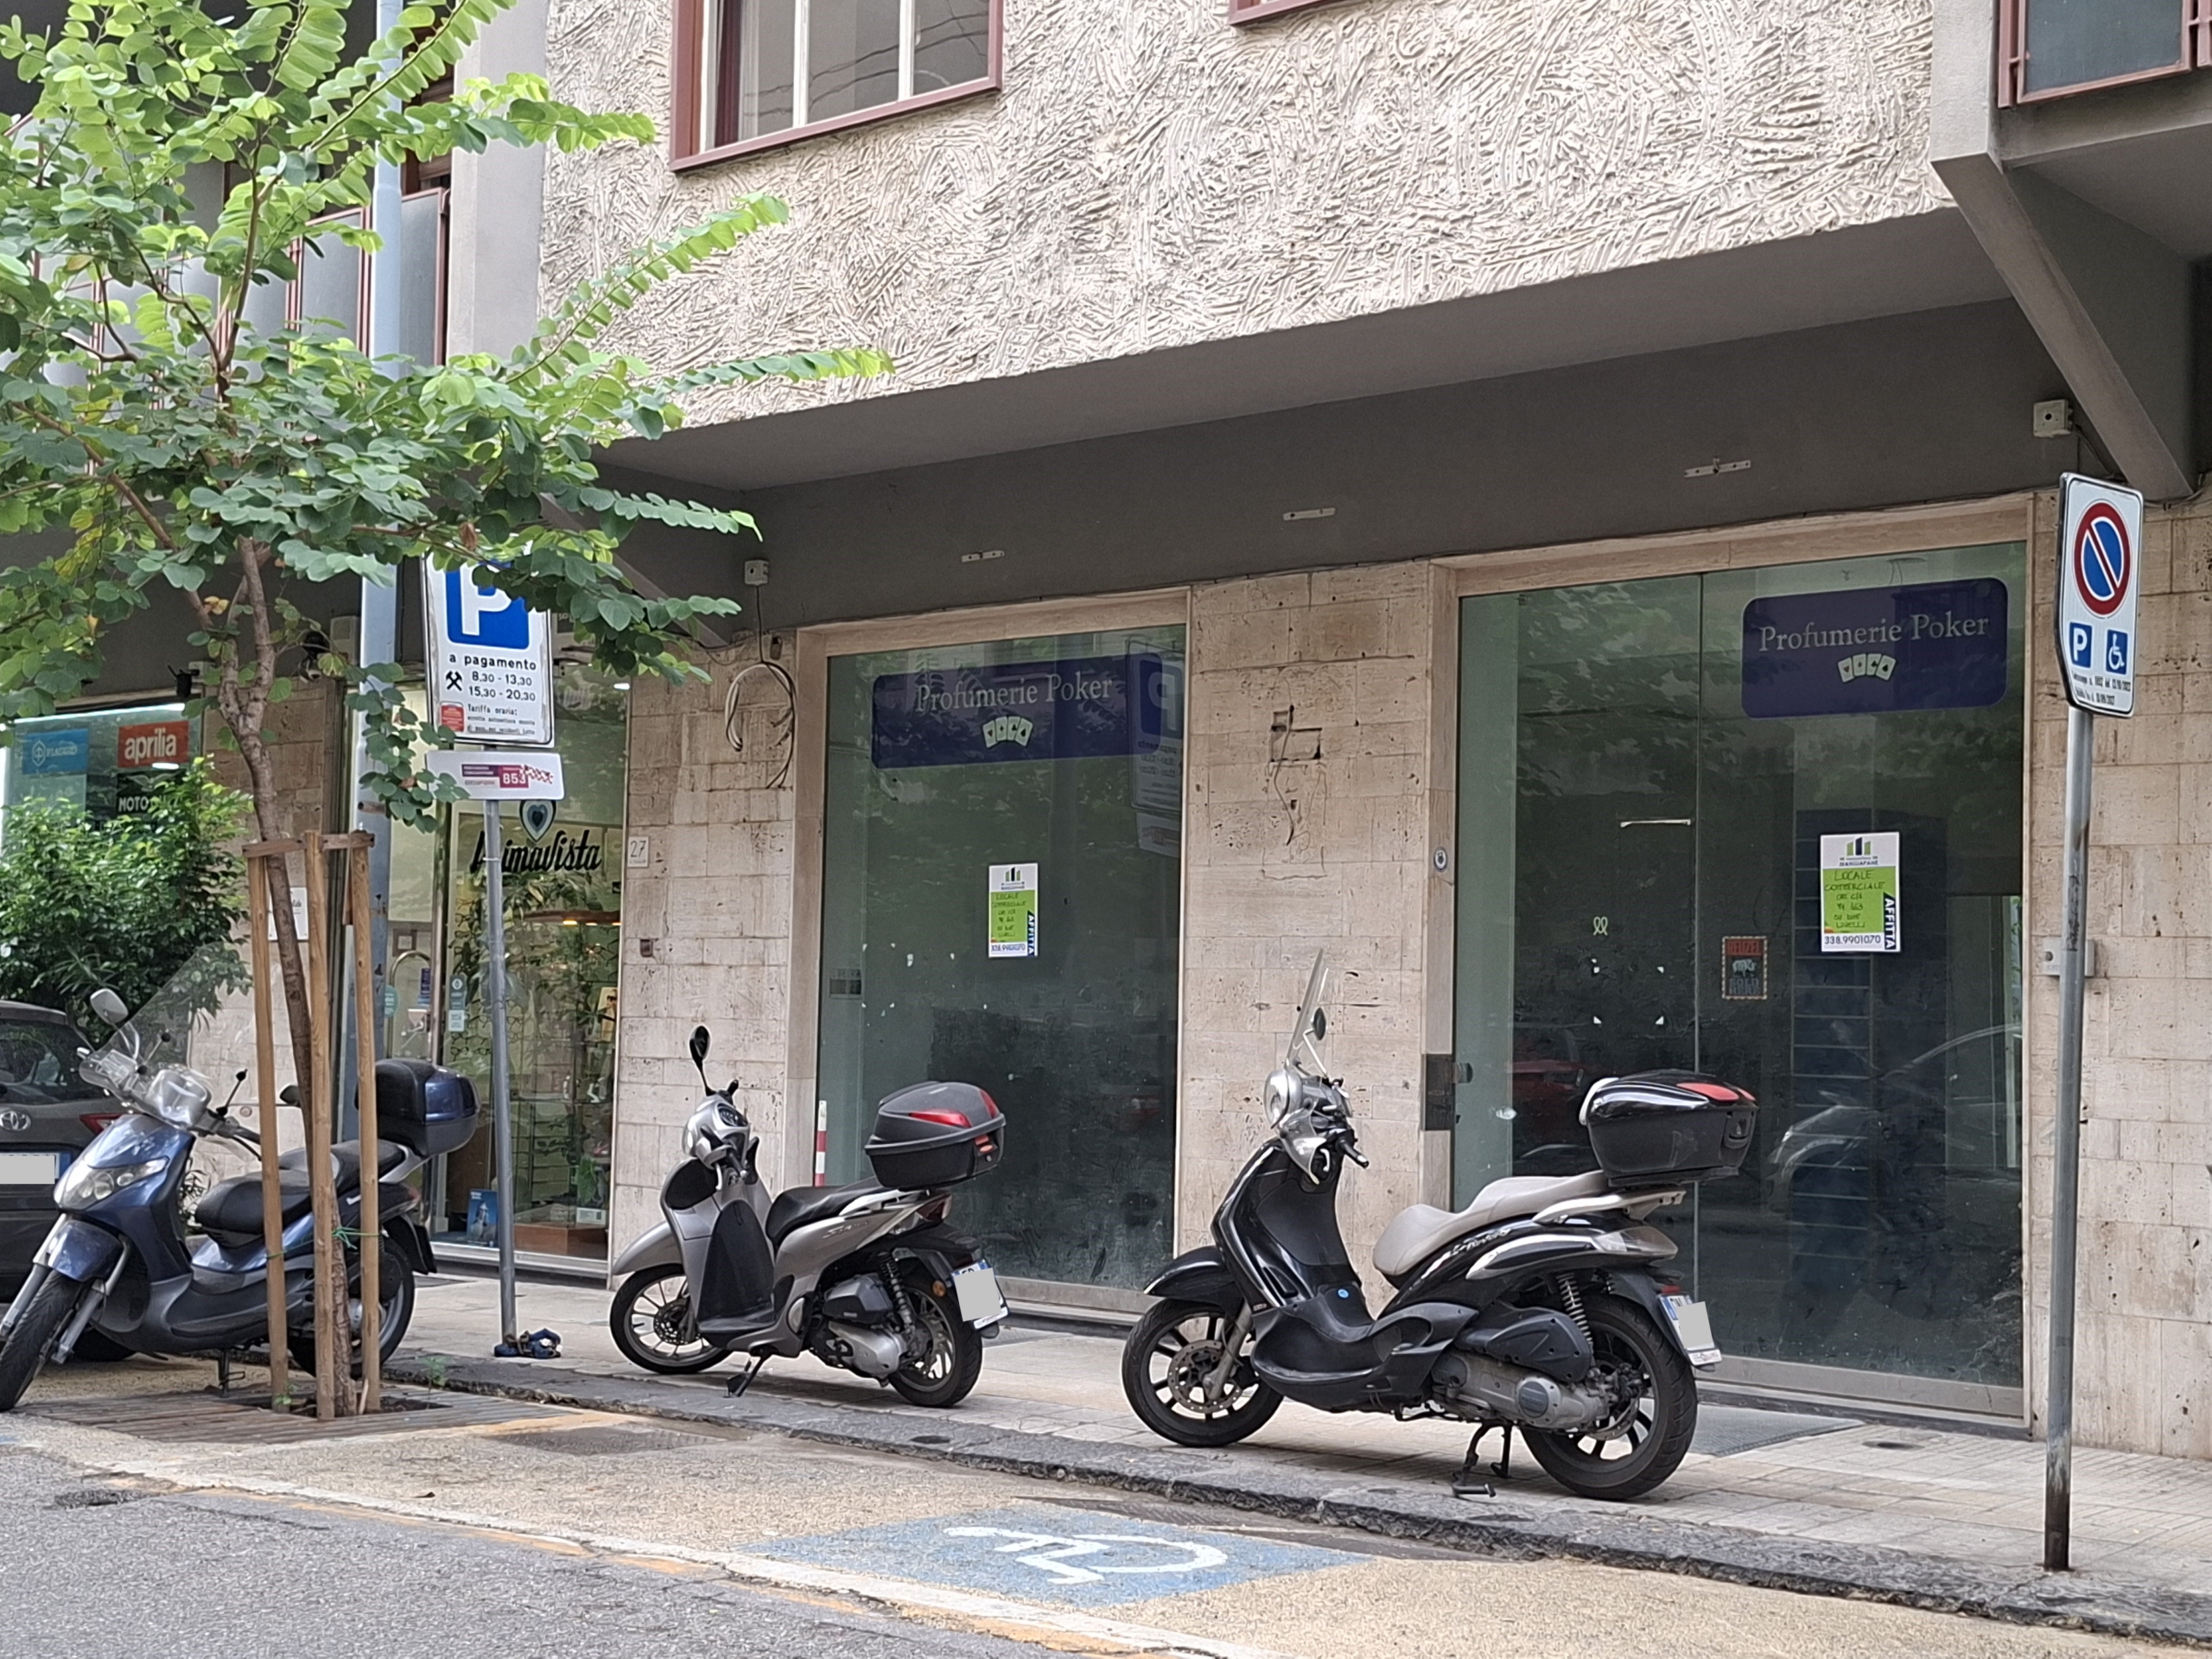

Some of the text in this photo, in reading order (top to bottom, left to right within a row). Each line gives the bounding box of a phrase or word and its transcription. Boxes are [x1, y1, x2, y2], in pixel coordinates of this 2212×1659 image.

[460, 560, 516, 636] P
[1758, 611, 1989, 652] Profumerie Poker
[2074, 628, 2087, 663] P
[449, 654, 537, 671] a pagamento
[915, 671, 1113, 712] Profumerie Poker
[467, 704, 491, 713] Tariffa
[124, 728, 176, 765] aprilia
[119, 796, 149, 812] MOTO
[631, 841, 646, 857] 27
[1834, 869, 1874, 880] LOCALE
[1824, 881, 1885, 892] COMMERCIALE
[1885, 899, 1896, 948] AFFITTA
[1825, 935, 1881, 944] 338.9901070
